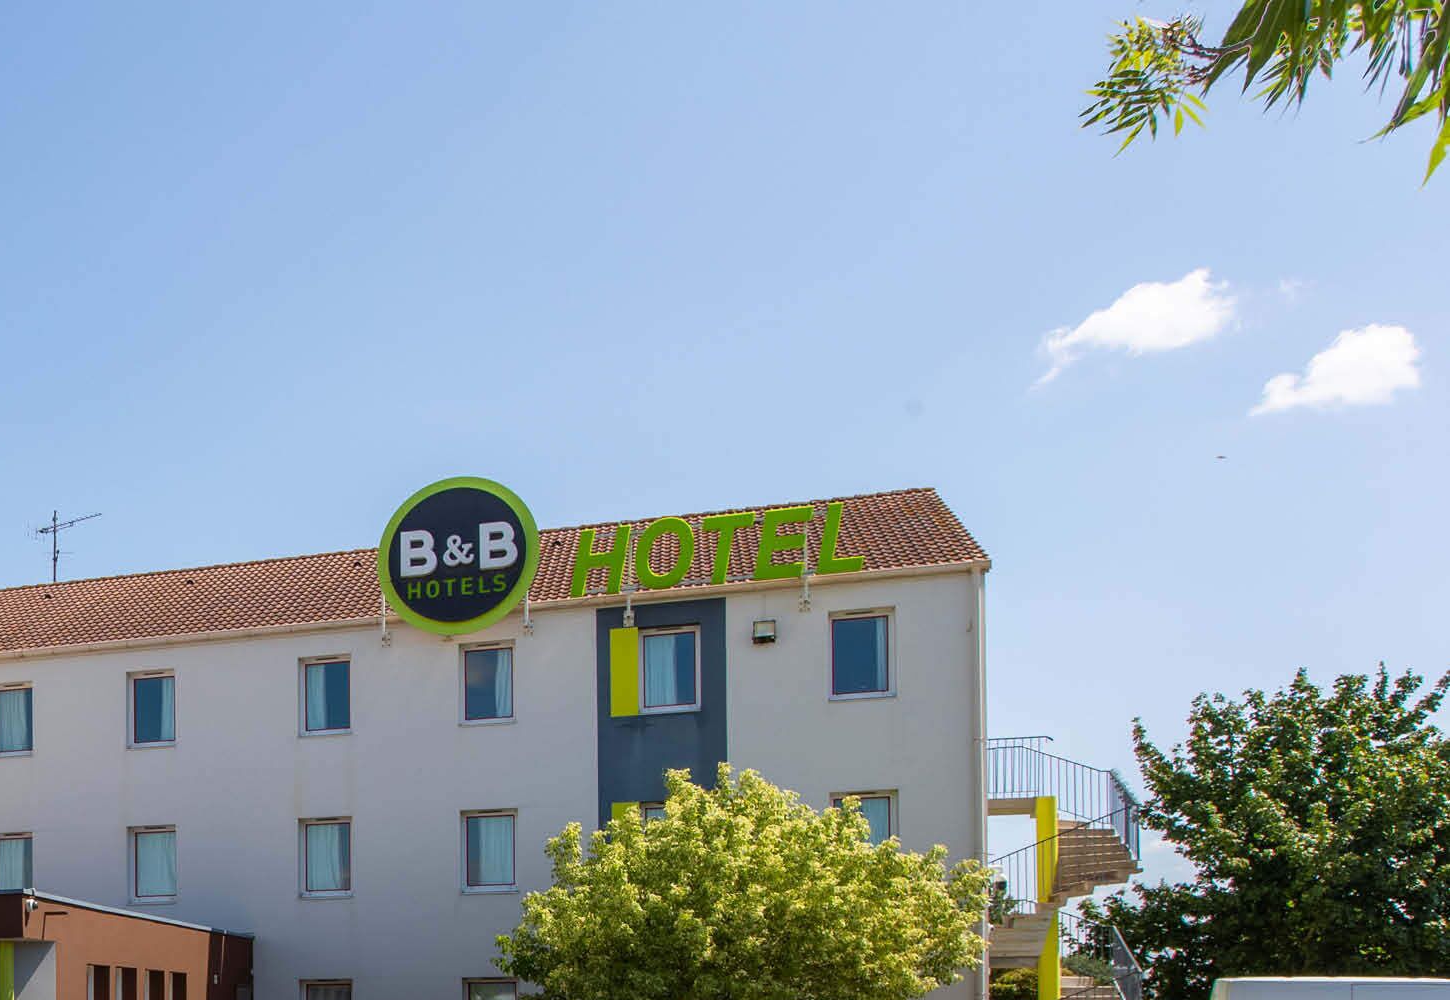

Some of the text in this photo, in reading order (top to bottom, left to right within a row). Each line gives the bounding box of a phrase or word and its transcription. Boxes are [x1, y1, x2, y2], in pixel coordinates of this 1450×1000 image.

[400, 521, 519, 577] B&B
[571, 502, 865, 598] HOTEL
[407, 573, 508, 600] HOTELS
